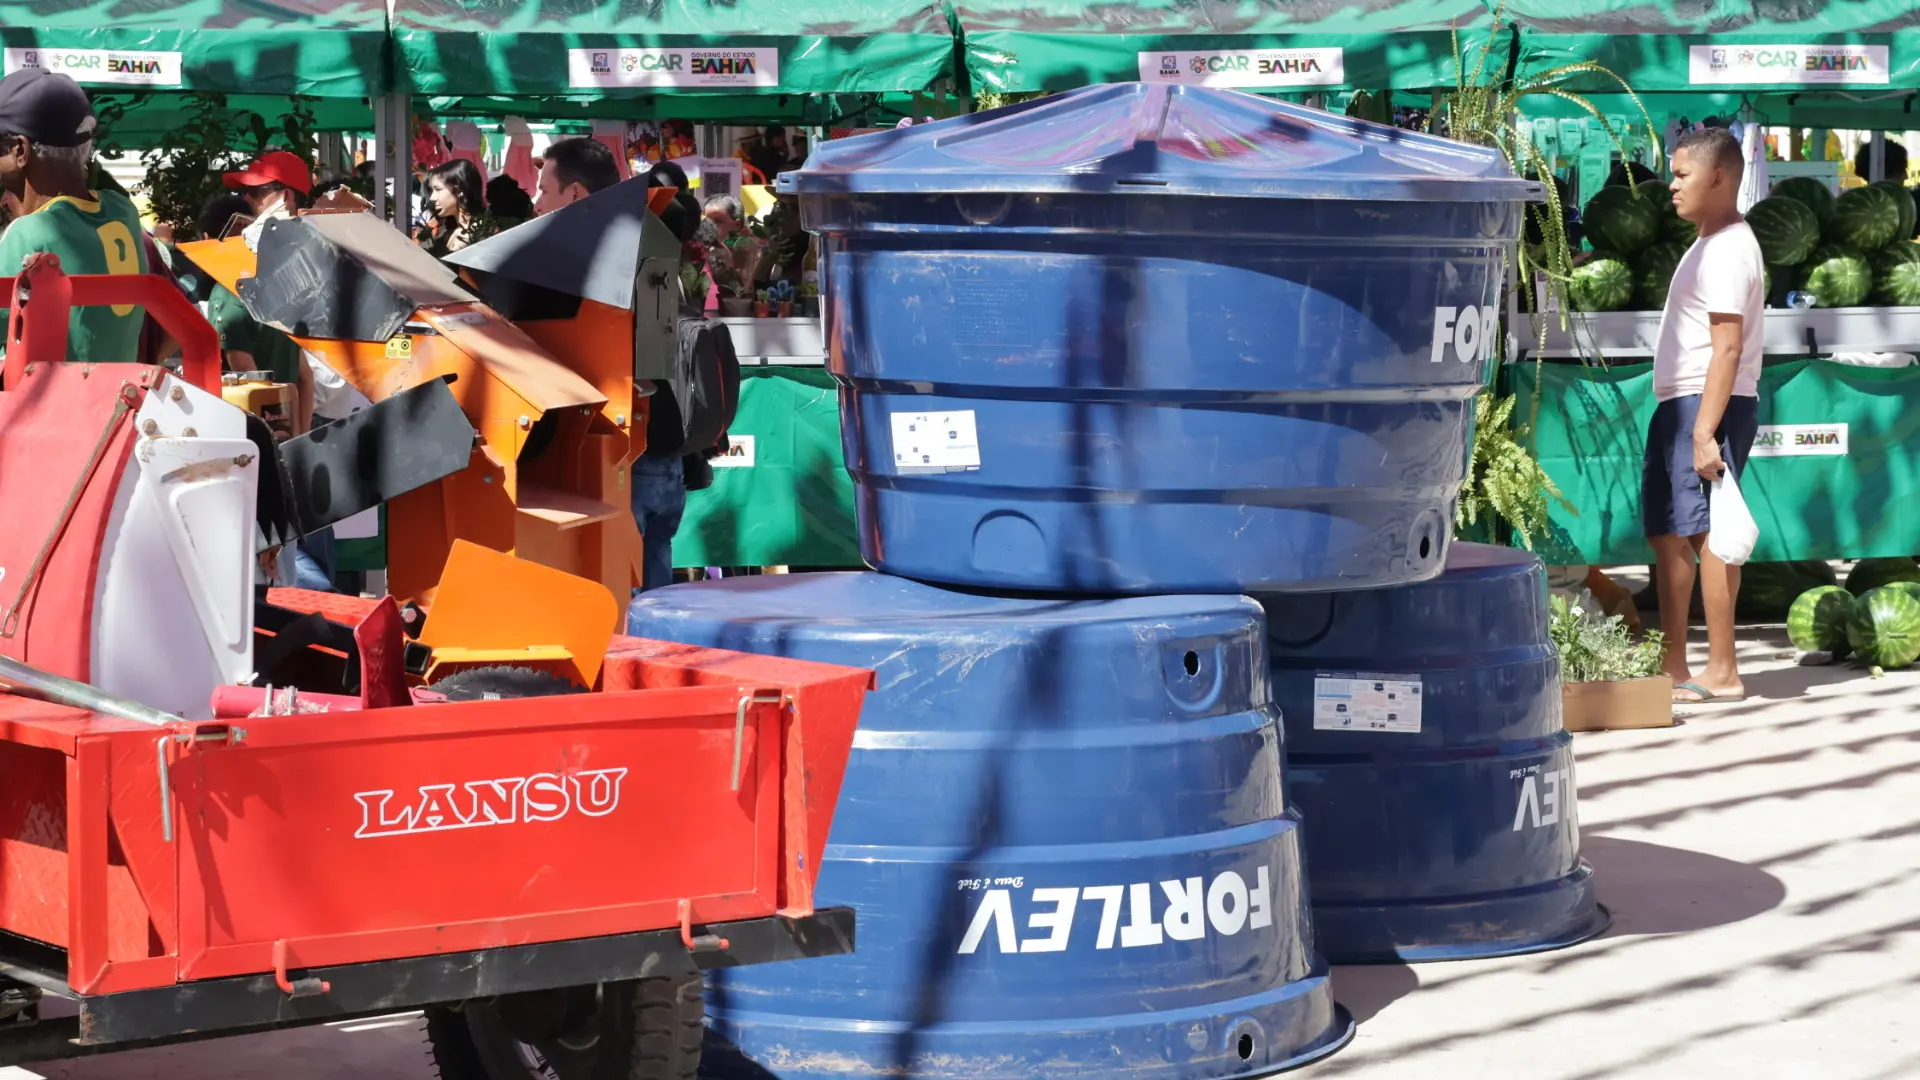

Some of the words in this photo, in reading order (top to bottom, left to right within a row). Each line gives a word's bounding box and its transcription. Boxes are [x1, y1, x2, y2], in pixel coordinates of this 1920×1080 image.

[64, 54, 101, 69] CAR
[108, 59, 162, 73] BAHIA
[640, 54, 684, 70] CAR
[691, 58, 756, 74] BAHIA
[1207, 55, 1251, 72] CAR
[1258, 59, 1321, 74] BAHIA
[1756, 51, 1798, 67] CAR
[1806, 56, 1868, 71] BAHIA
[1794, 432, 1840, 446] BAHIA
[354, 767, 628, 839] LANSU
[957, 878, 981, 890] Fiel
[994, 876, 1023, 888] Deus
[957, 865, 1273, 955] FORTLEV
